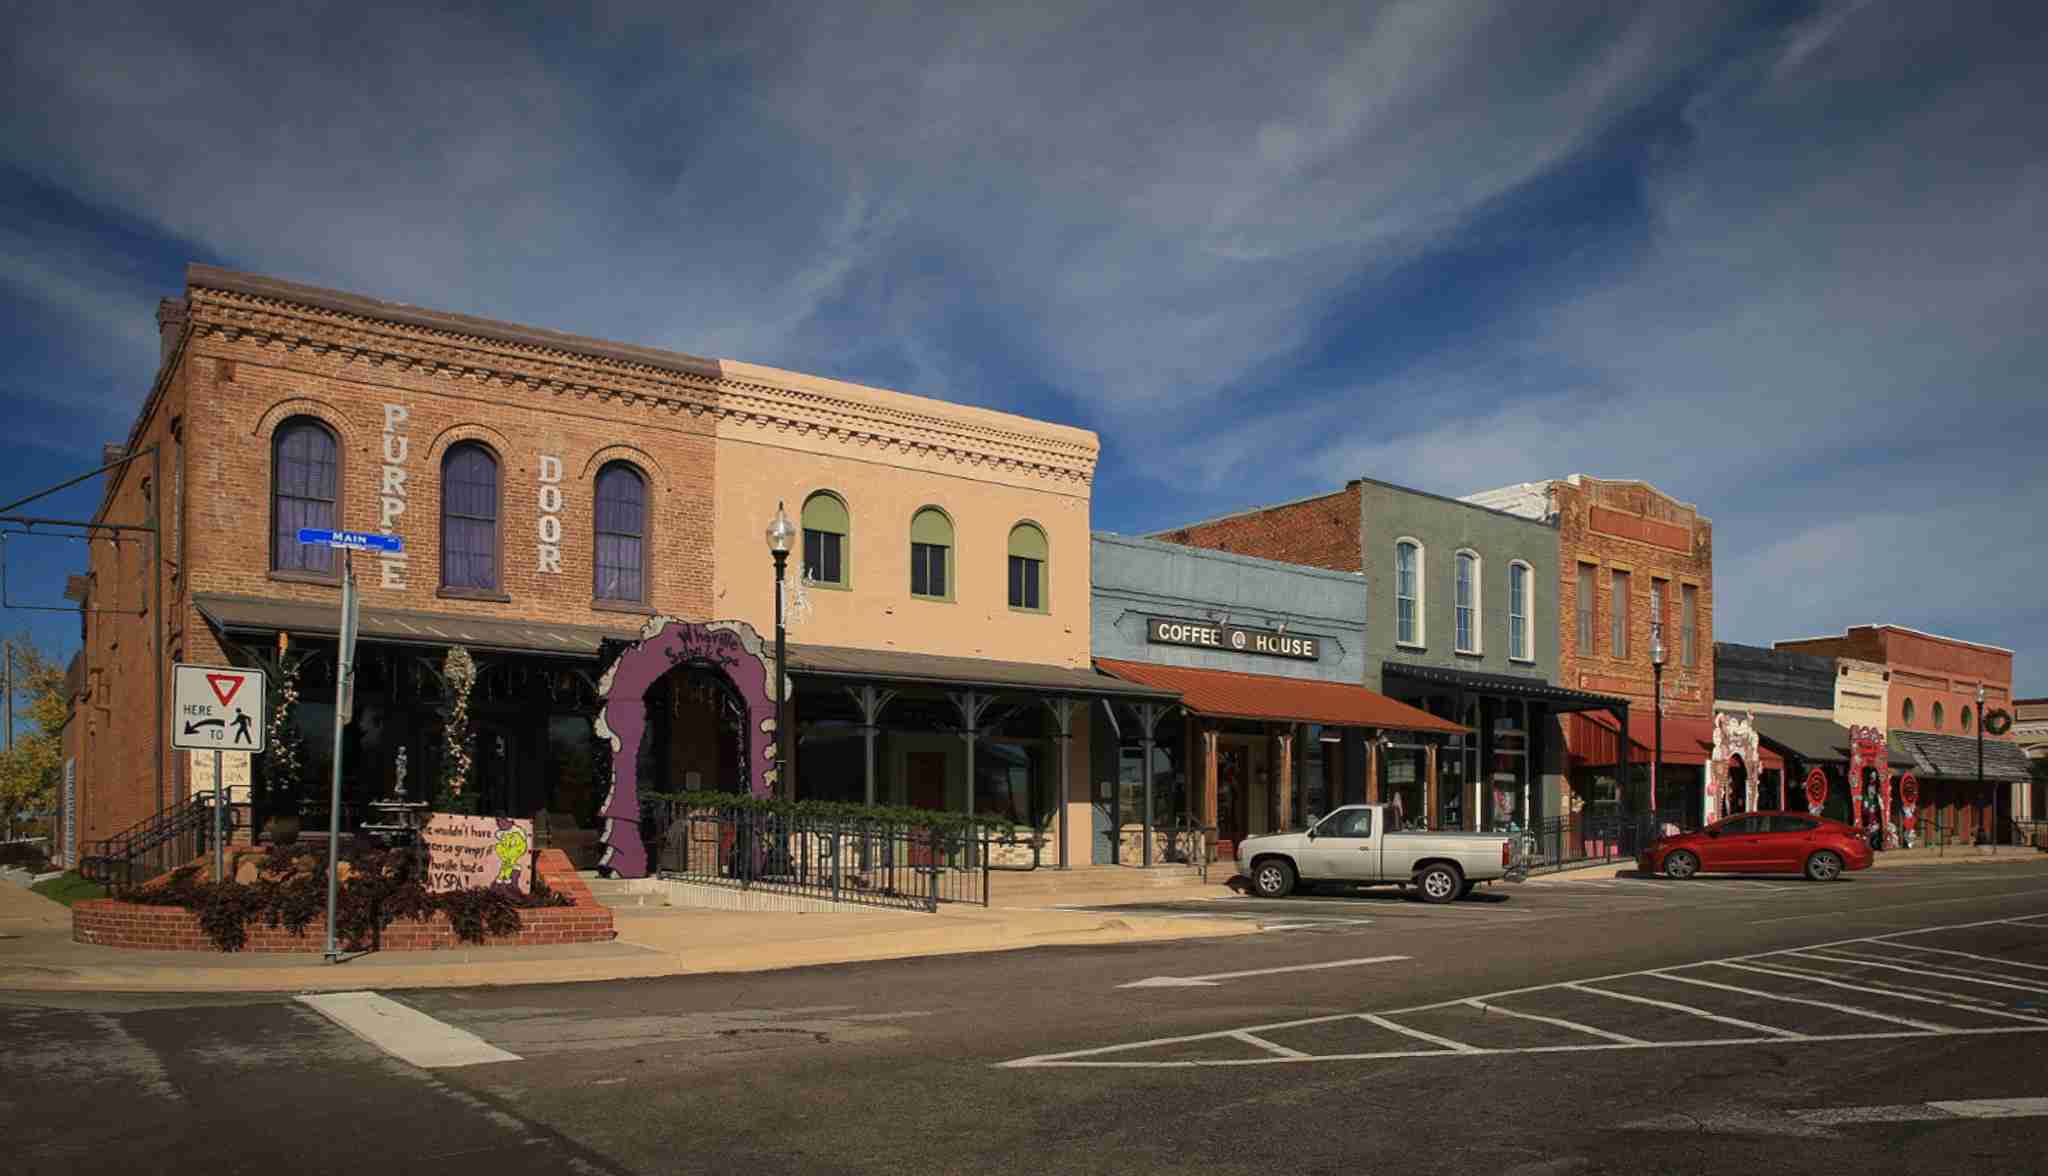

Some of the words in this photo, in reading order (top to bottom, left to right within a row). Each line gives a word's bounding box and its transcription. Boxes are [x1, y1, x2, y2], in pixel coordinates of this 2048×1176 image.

[538, 455, 562, 574] DOOR
[332, 532, 367, 544] MAIN
[1158, 623, 1220, 646] COFFEE
[1257, 636, 1313, 656] HOUSE
[184, 704, 213, 716] HERE
[209, 730, 224, 741] TO
